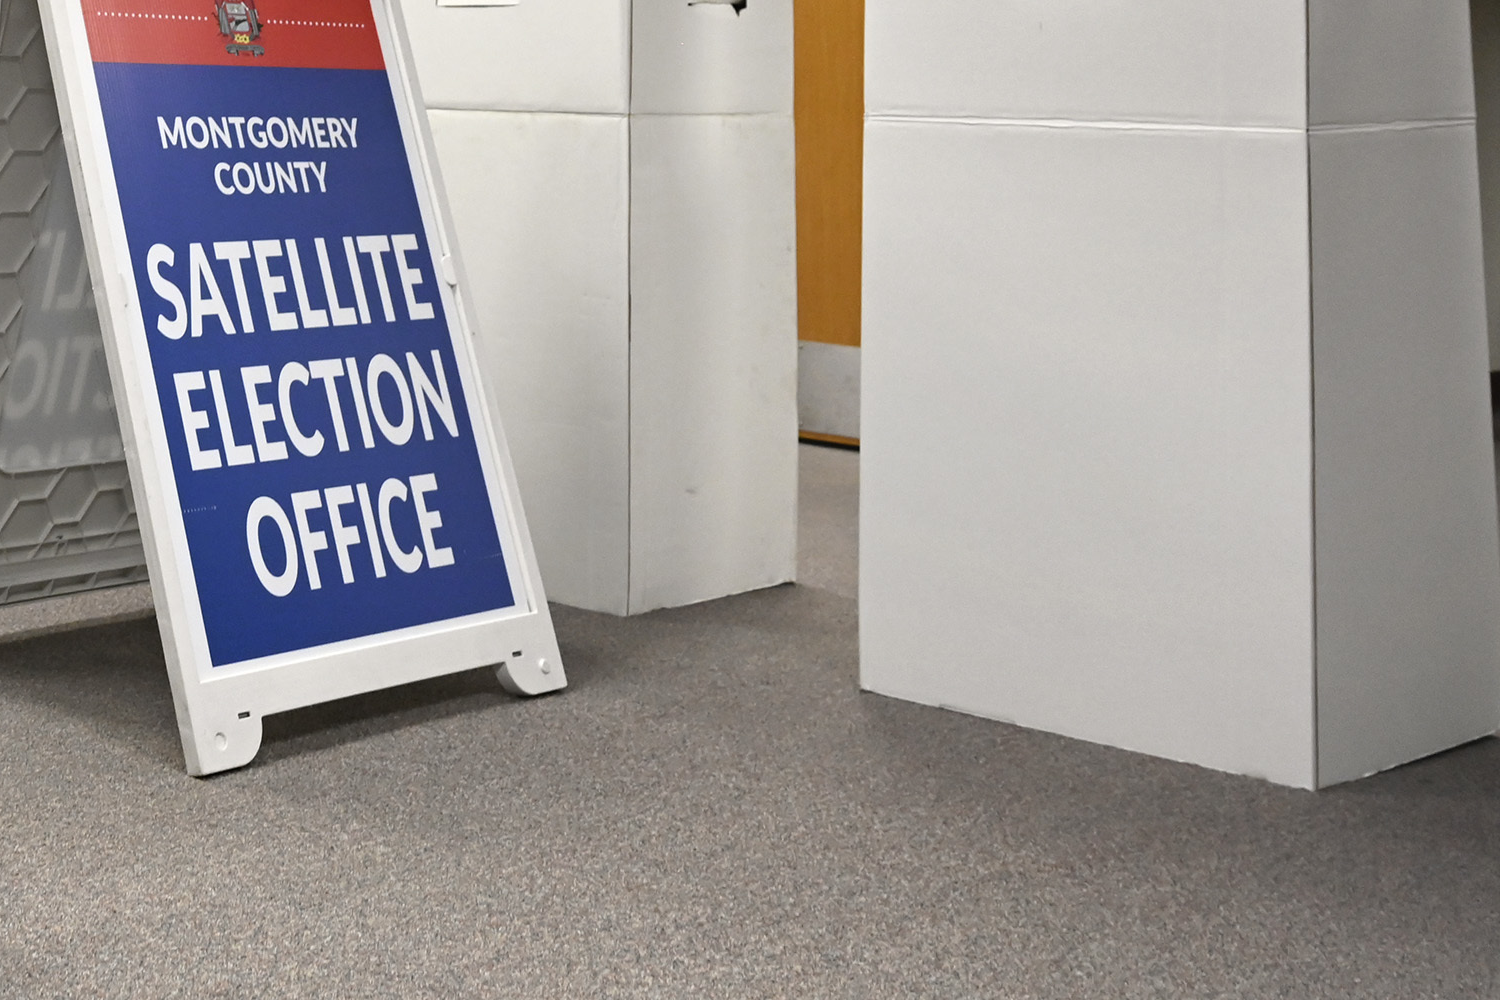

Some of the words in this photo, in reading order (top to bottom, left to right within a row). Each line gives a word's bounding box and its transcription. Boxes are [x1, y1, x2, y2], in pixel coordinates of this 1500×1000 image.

[157, 116, 358, 149] MONTGOMERY
[214, 162, 327, 195] COUNTY
[146, 234, 435, 340] SATELLITE
[173, 349, 460, 472] ELECTION
[246, 473, 455, 597] OFFICE
